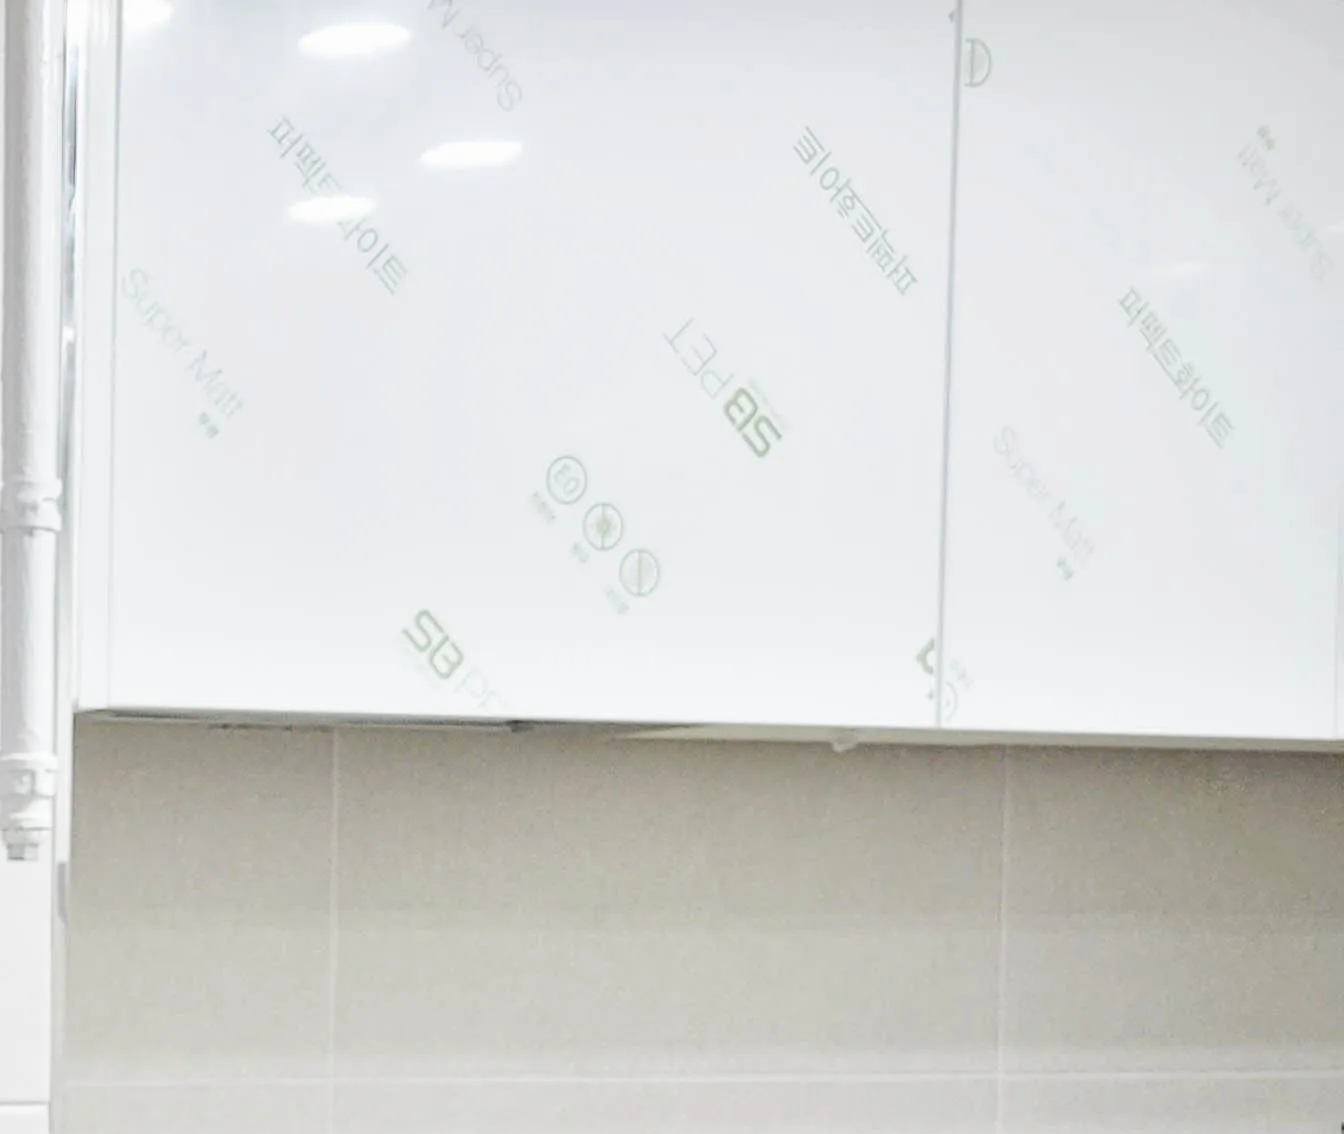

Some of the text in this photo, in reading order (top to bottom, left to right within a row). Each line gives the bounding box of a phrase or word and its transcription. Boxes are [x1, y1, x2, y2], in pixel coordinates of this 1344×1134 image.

[793, 125, 918, 297] 퍼펙트화이트
[661, 315, 735, 401] PET
[1117, 285, 1236, 450] 퍼펙트화이트
